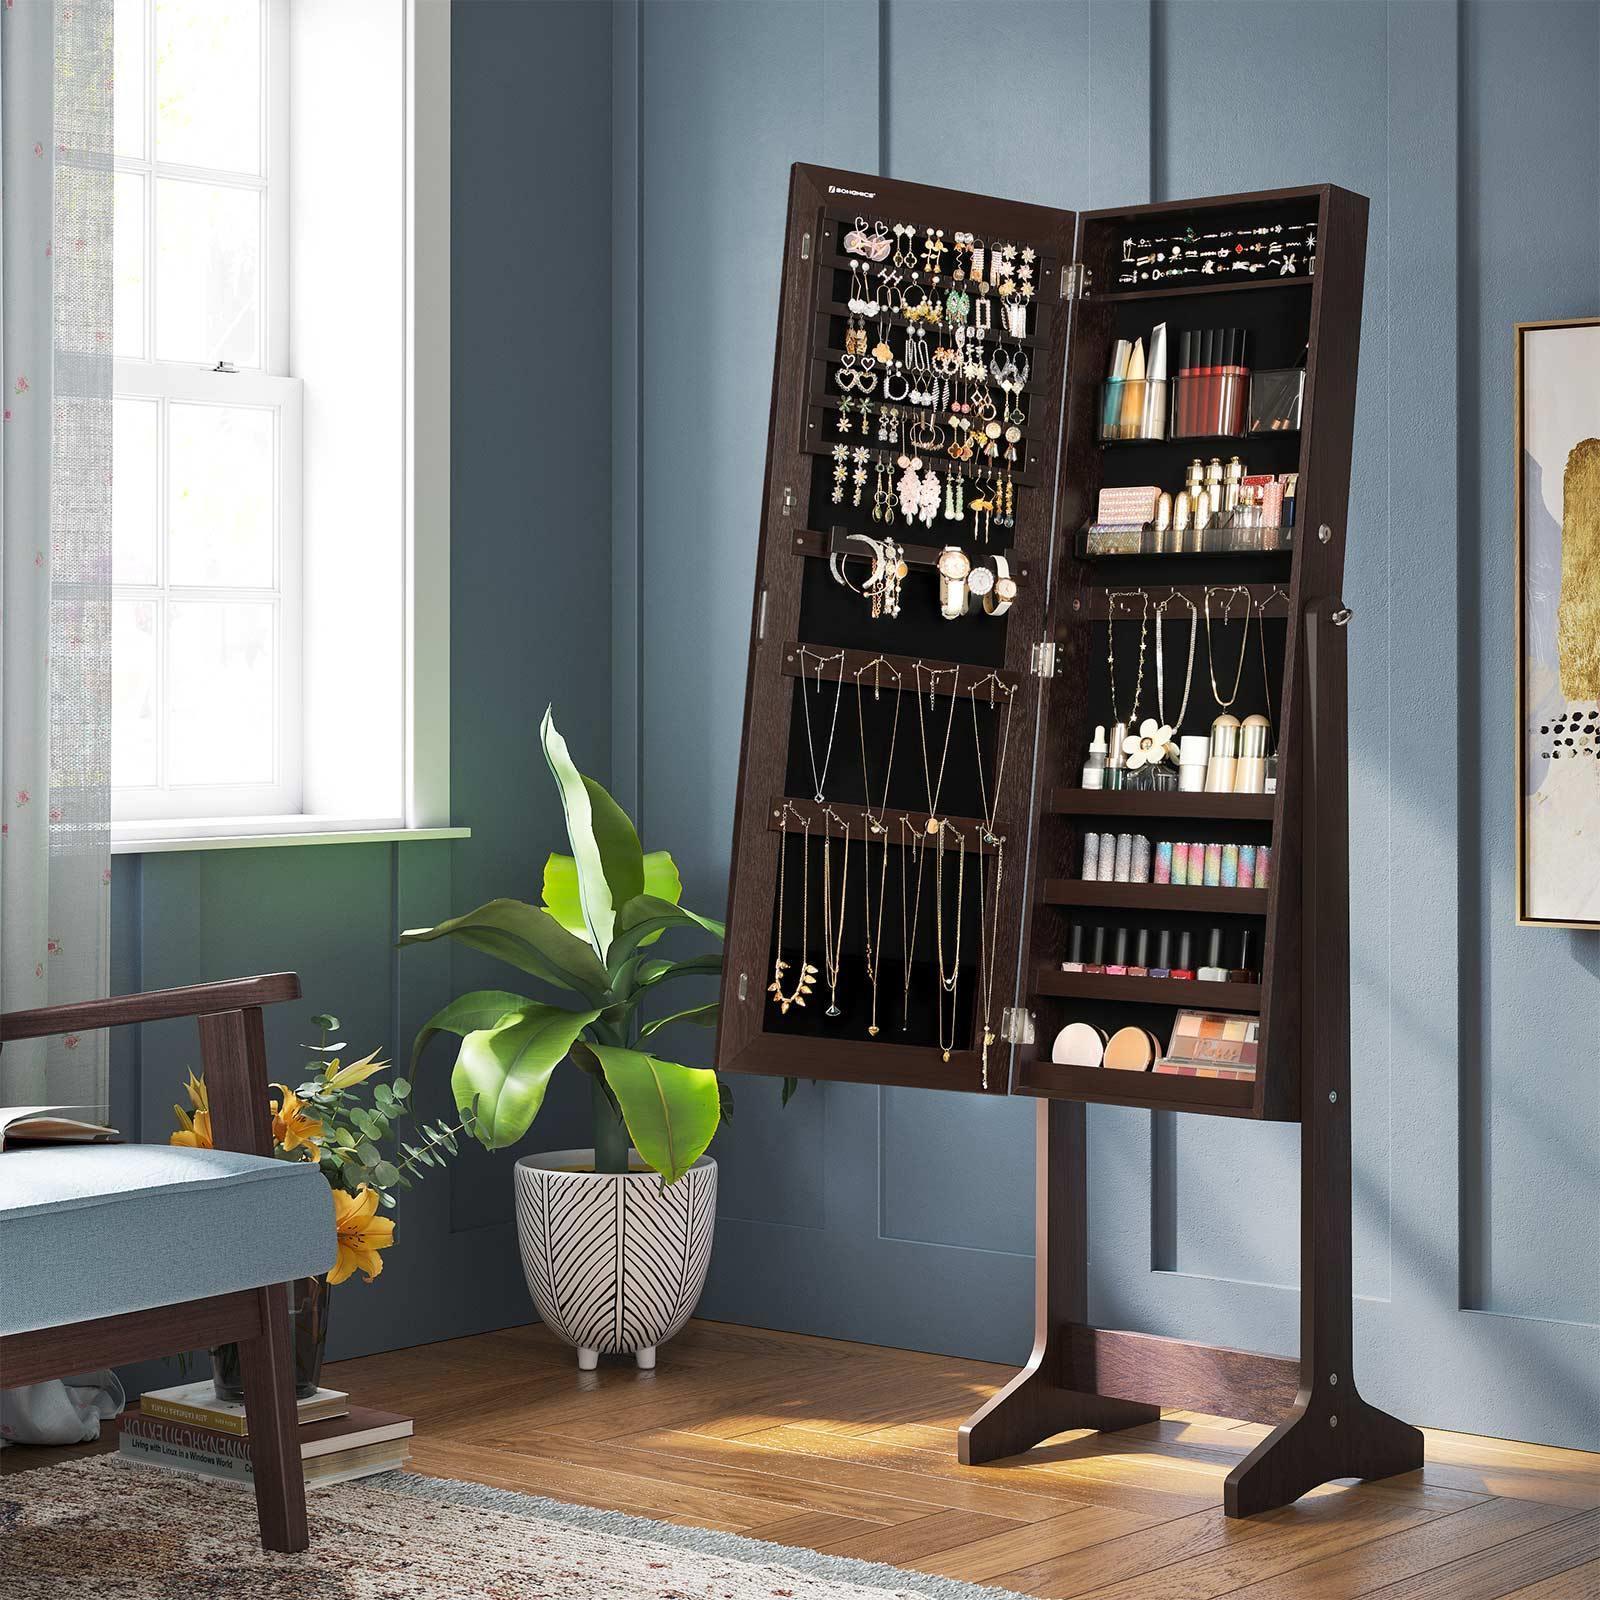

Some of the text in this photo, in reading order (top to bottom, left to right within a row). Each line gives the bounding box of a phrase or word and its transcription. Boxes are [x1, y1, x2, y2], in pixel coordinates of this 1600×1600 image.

[131, 1438, 149, 1452] Living
[162, 1445, 178, 1457] Linux
[190, 1451, 215, 1465] Windows
[216, 1457, 233, 1469] World
